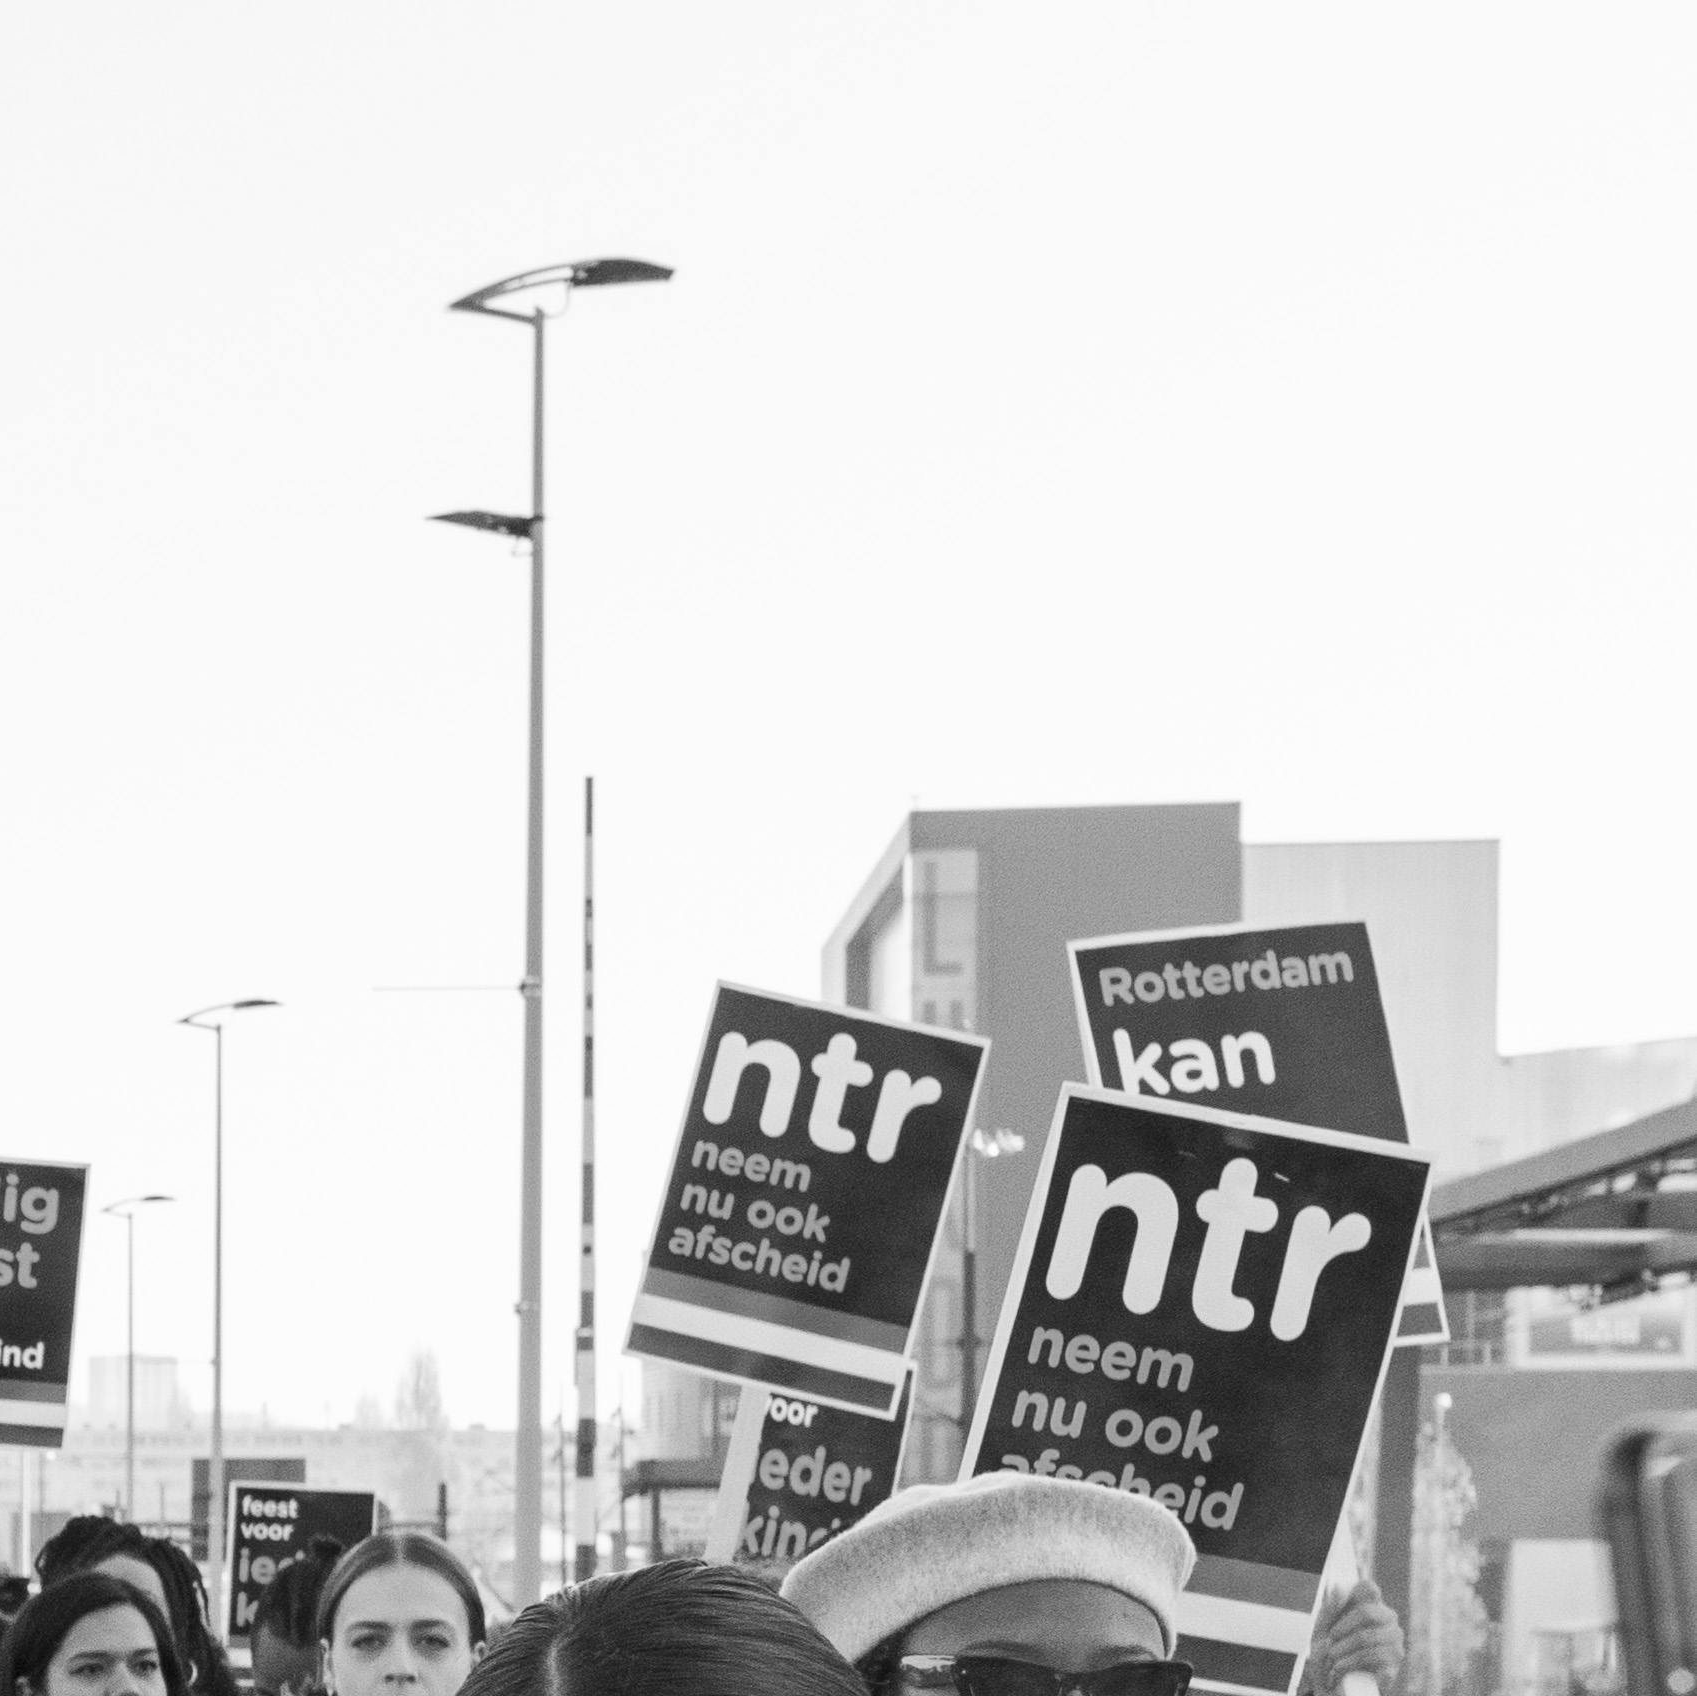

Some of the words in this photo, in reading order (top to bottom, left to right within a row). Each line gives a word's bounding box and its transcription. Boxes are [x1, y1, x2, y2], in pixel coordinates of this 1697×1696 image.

[1099, 949, 1354, 1007] Rotterdam
[1113, 1028, 1276, 1095] kan
[703, 1031, 942, 1163] ntr
[691, 1140, 811, 1192] neem
[680, 1183, 735, 1220] nu
[747, 1202, 830, 1243] ook
[668, 1224, 850, 1293] afscheid
[1046, 1157, 1371, 1341] ntr
[1028, 1326, 1194, 1392] neem
[769, 1397, 819, 1428] oor
[1011, 1390, 1087, 1438] nu
[1105, 1408, 1219, 1462] ook
[757, 1445, 873, 1506] eder
[241, 1523, 294, 1541] voor
[242, 1495, 299, 1519] feest
